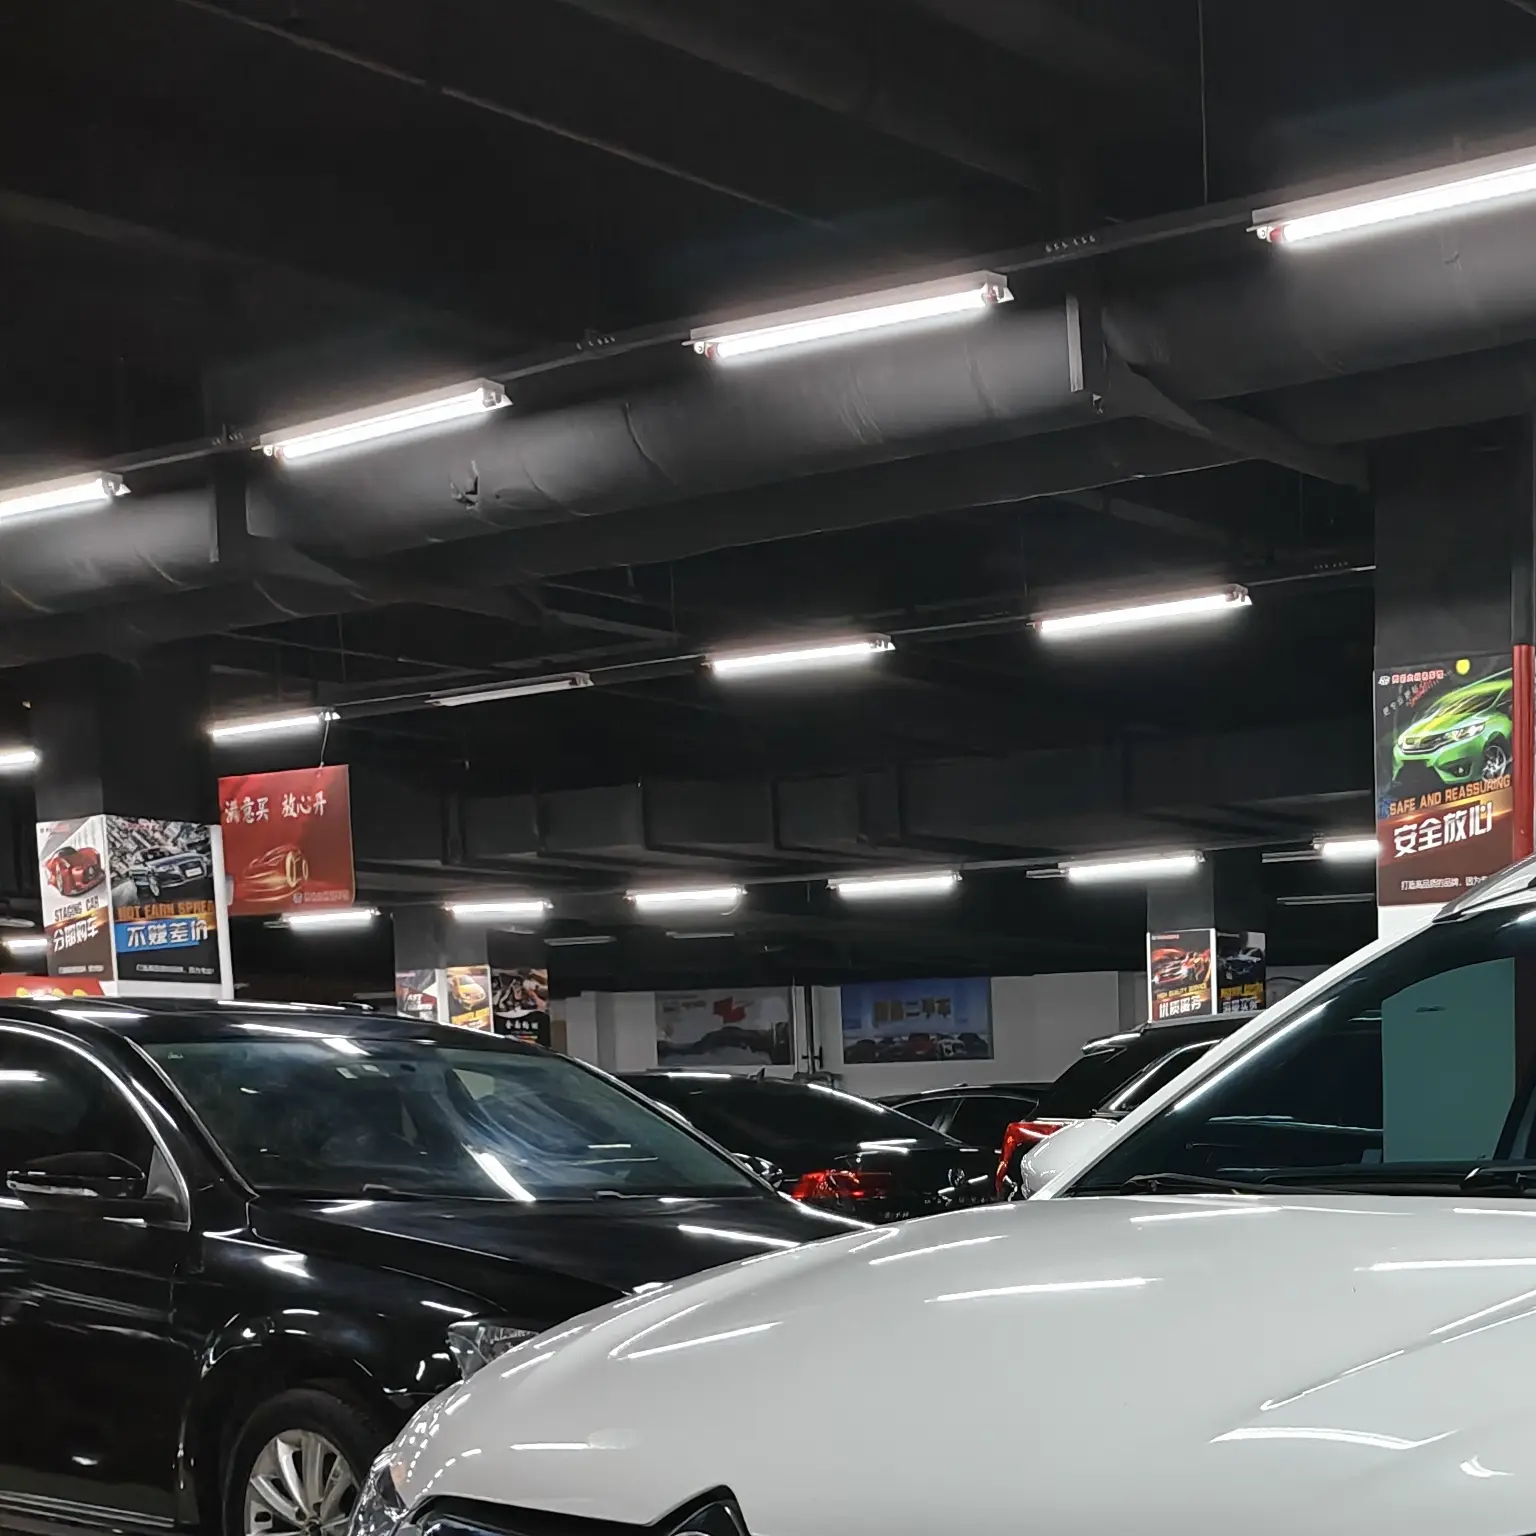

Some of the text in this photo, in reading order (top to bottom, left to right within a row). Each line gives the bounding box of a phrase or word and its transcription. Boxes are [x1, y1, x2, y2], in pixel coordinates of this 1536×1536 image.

[224, 796, 270, 825] 满意买
[281, 790, 328, 819] 放心开
[1389, 773, 1512, 816] SAFE AND REASSURING
[1393, 801, 1493, 859] 安全放心
